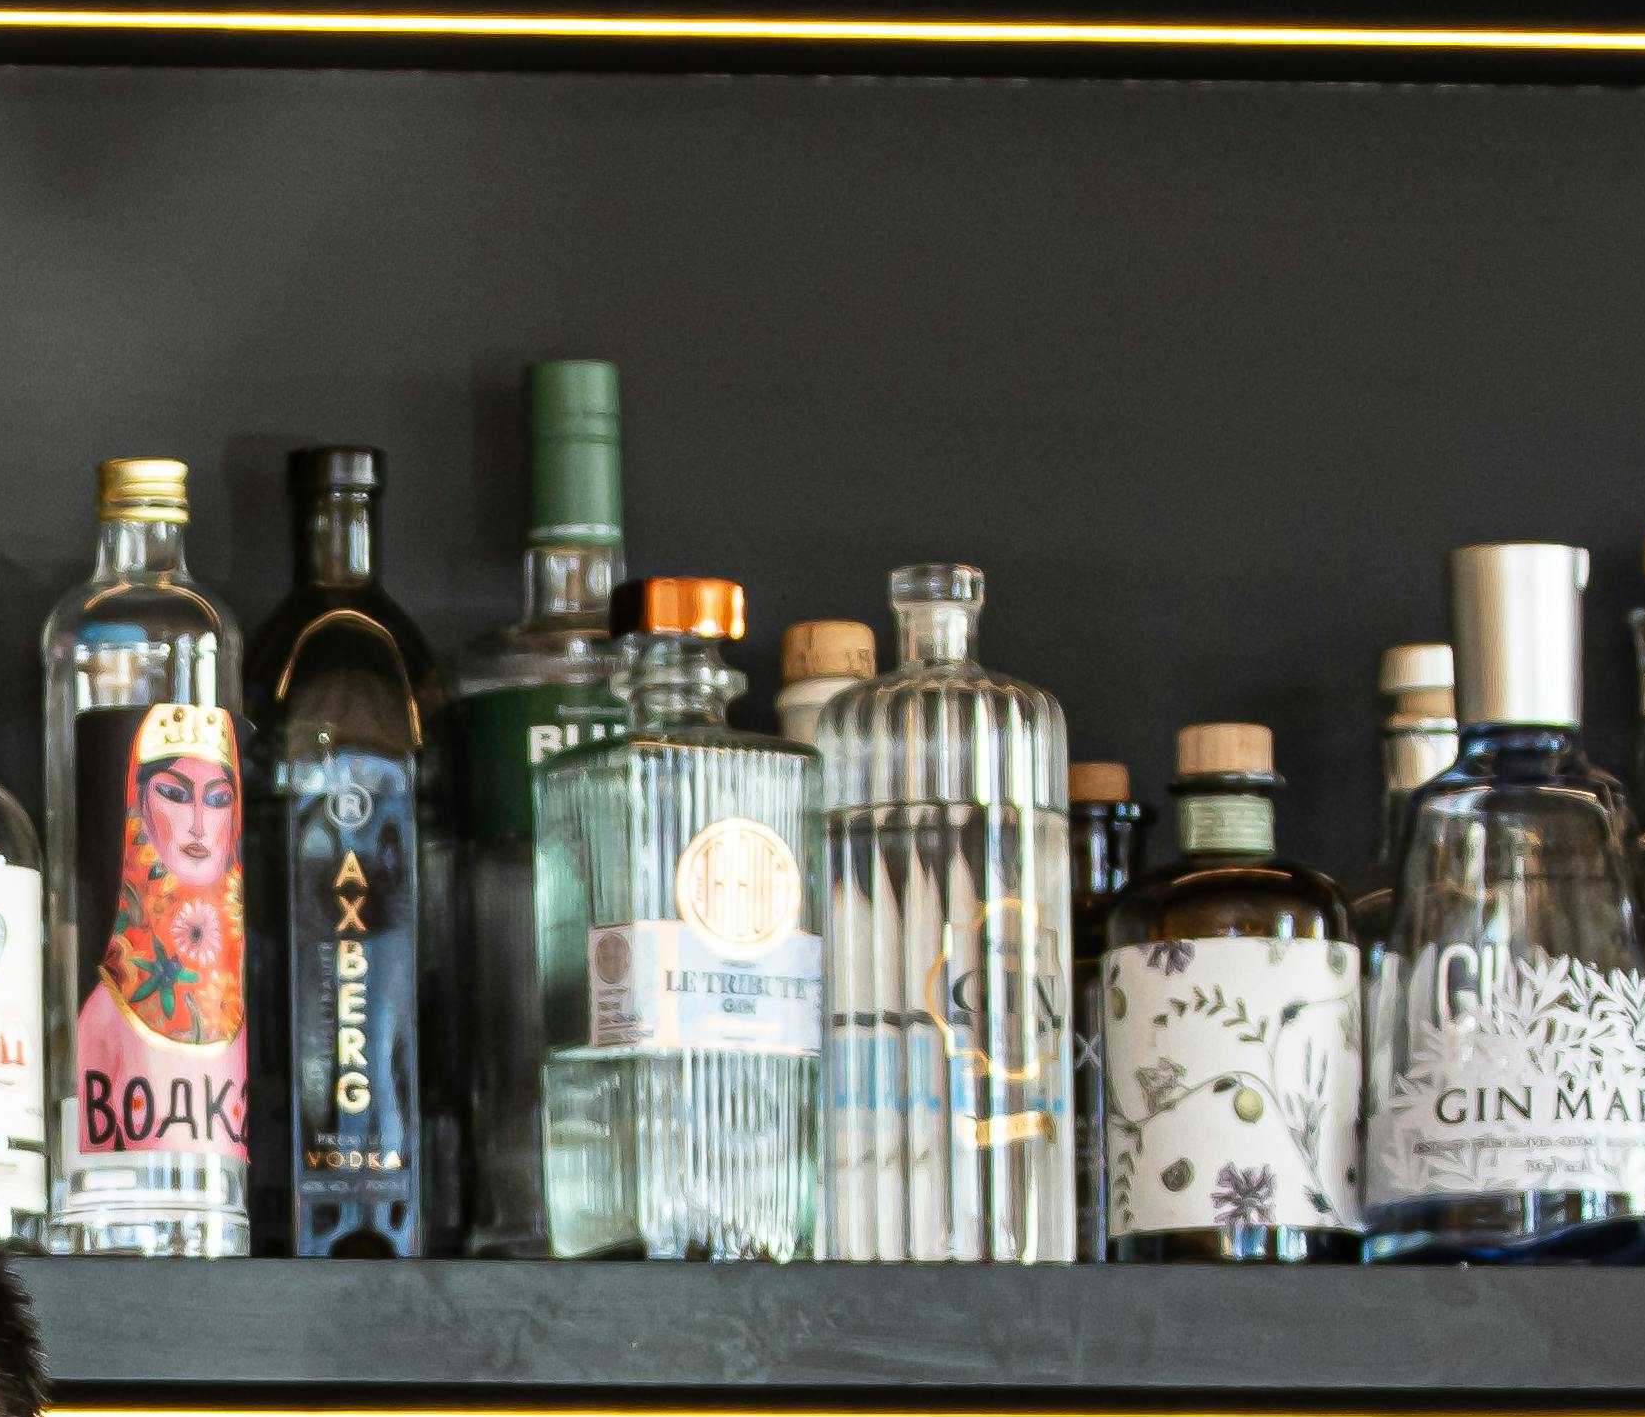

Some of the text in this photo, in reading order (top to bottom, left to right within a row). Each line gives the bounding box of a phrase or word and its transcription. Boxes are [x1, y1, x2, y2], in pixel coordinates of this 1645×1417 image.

[335, 848, 371, 1115] AXBERG
[665, 970, 809, 999] LE TRIBUTE
[1436, 1086, 1533, 1124] GIN
[307, 1150, 402, 1170] VODKA
